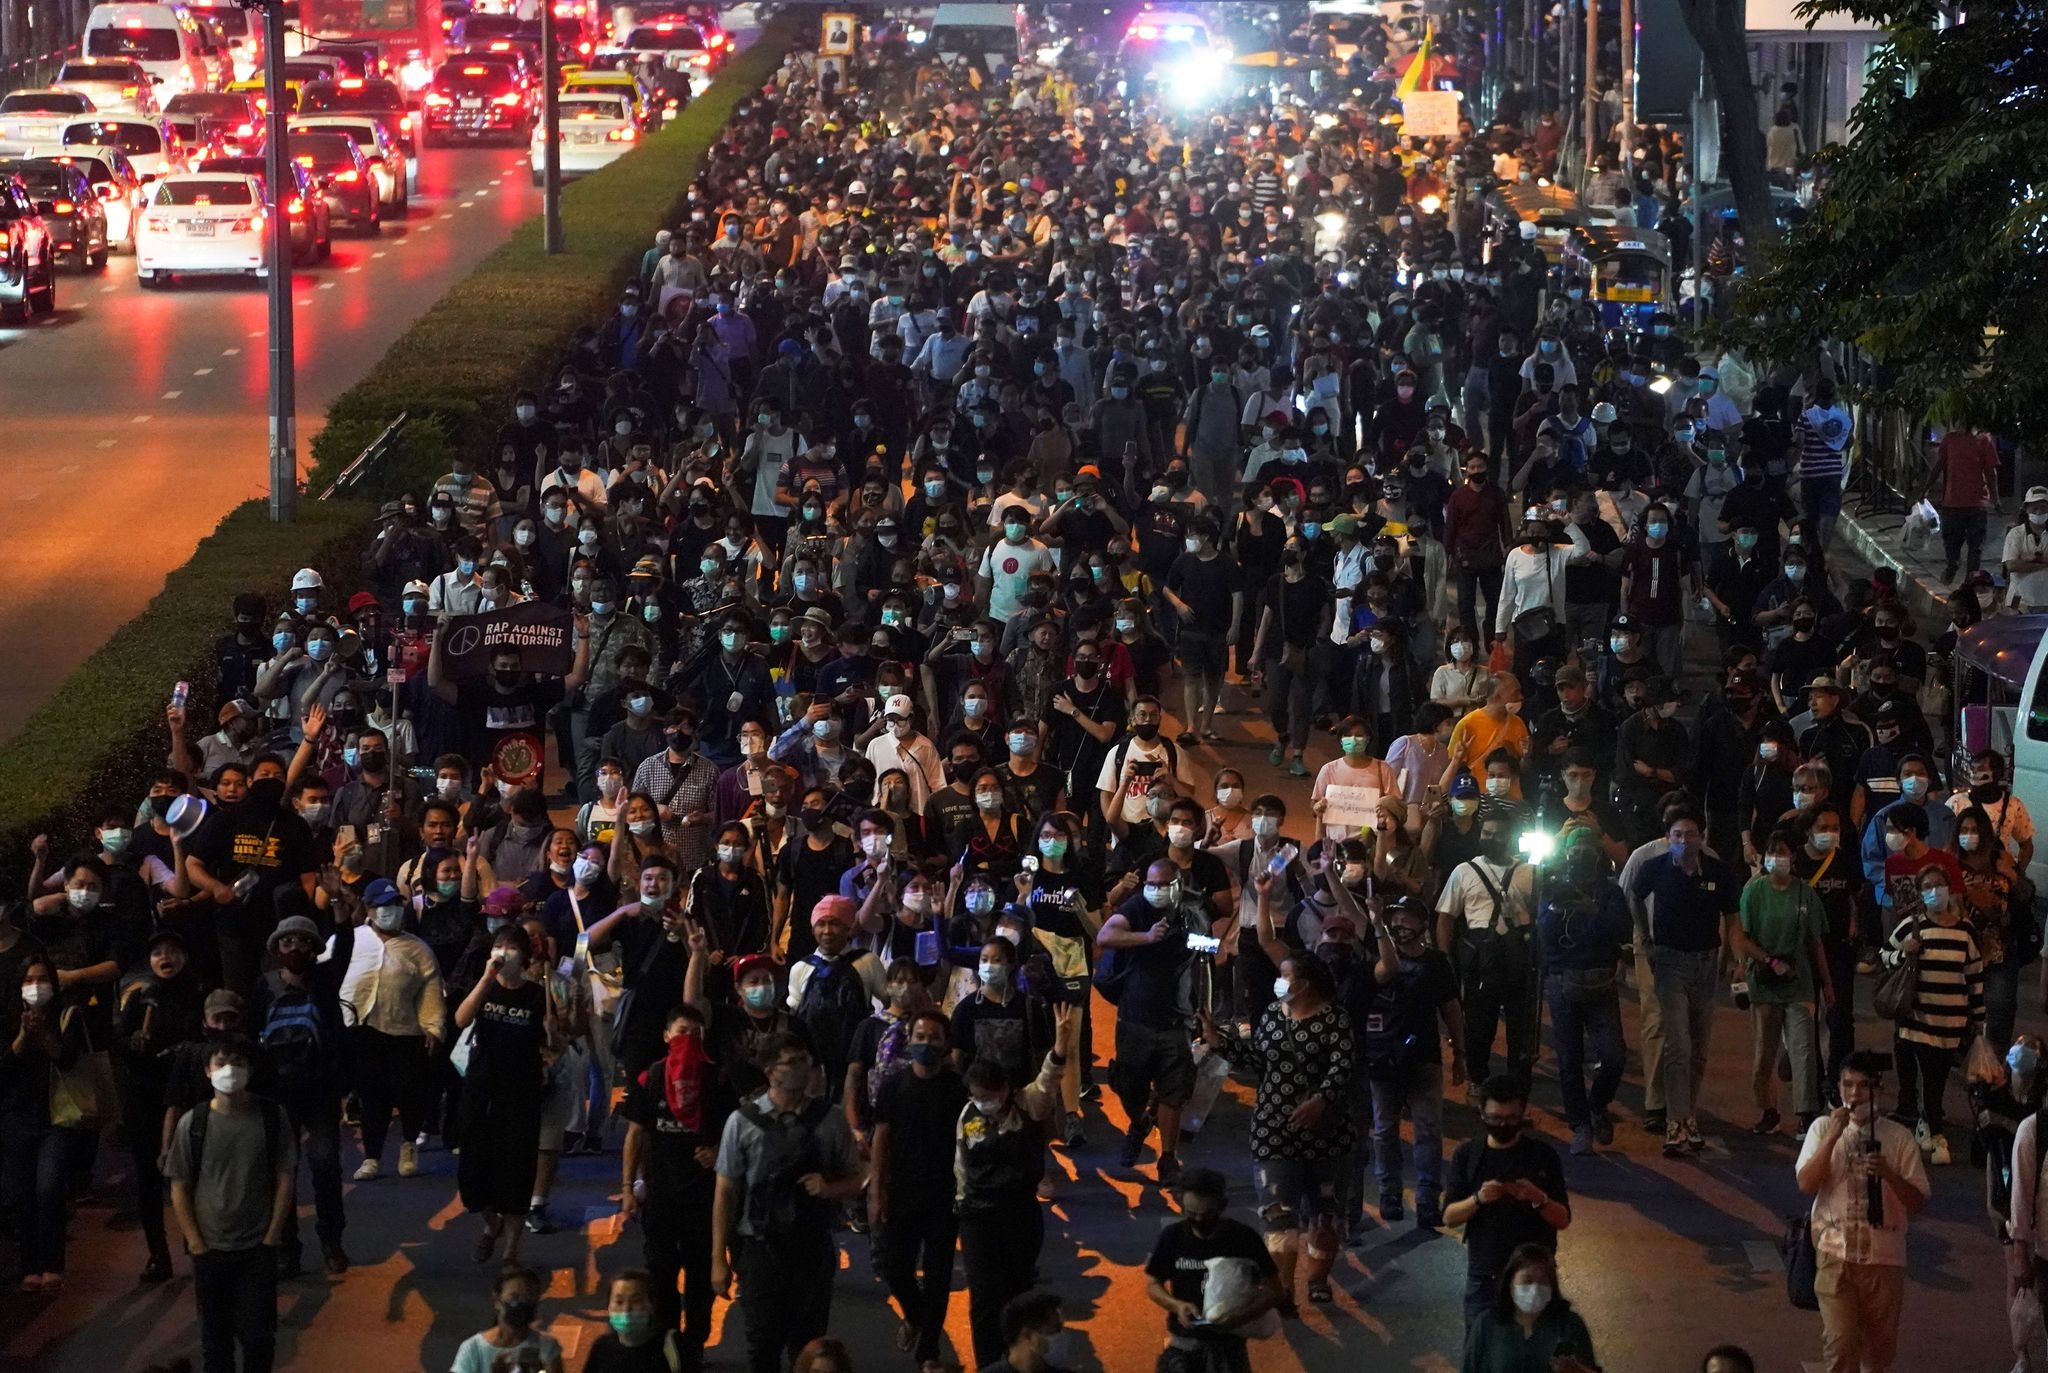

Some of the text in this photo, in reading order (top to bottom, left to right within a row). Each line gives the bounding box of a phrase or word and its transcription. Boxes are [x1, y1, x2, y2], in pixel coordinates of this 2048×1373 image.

[485, 621, 509, 635] RAP
[484, 632, 562, 648] DICTATORSHIP
[508, 1007, 532, 1020] CAT
